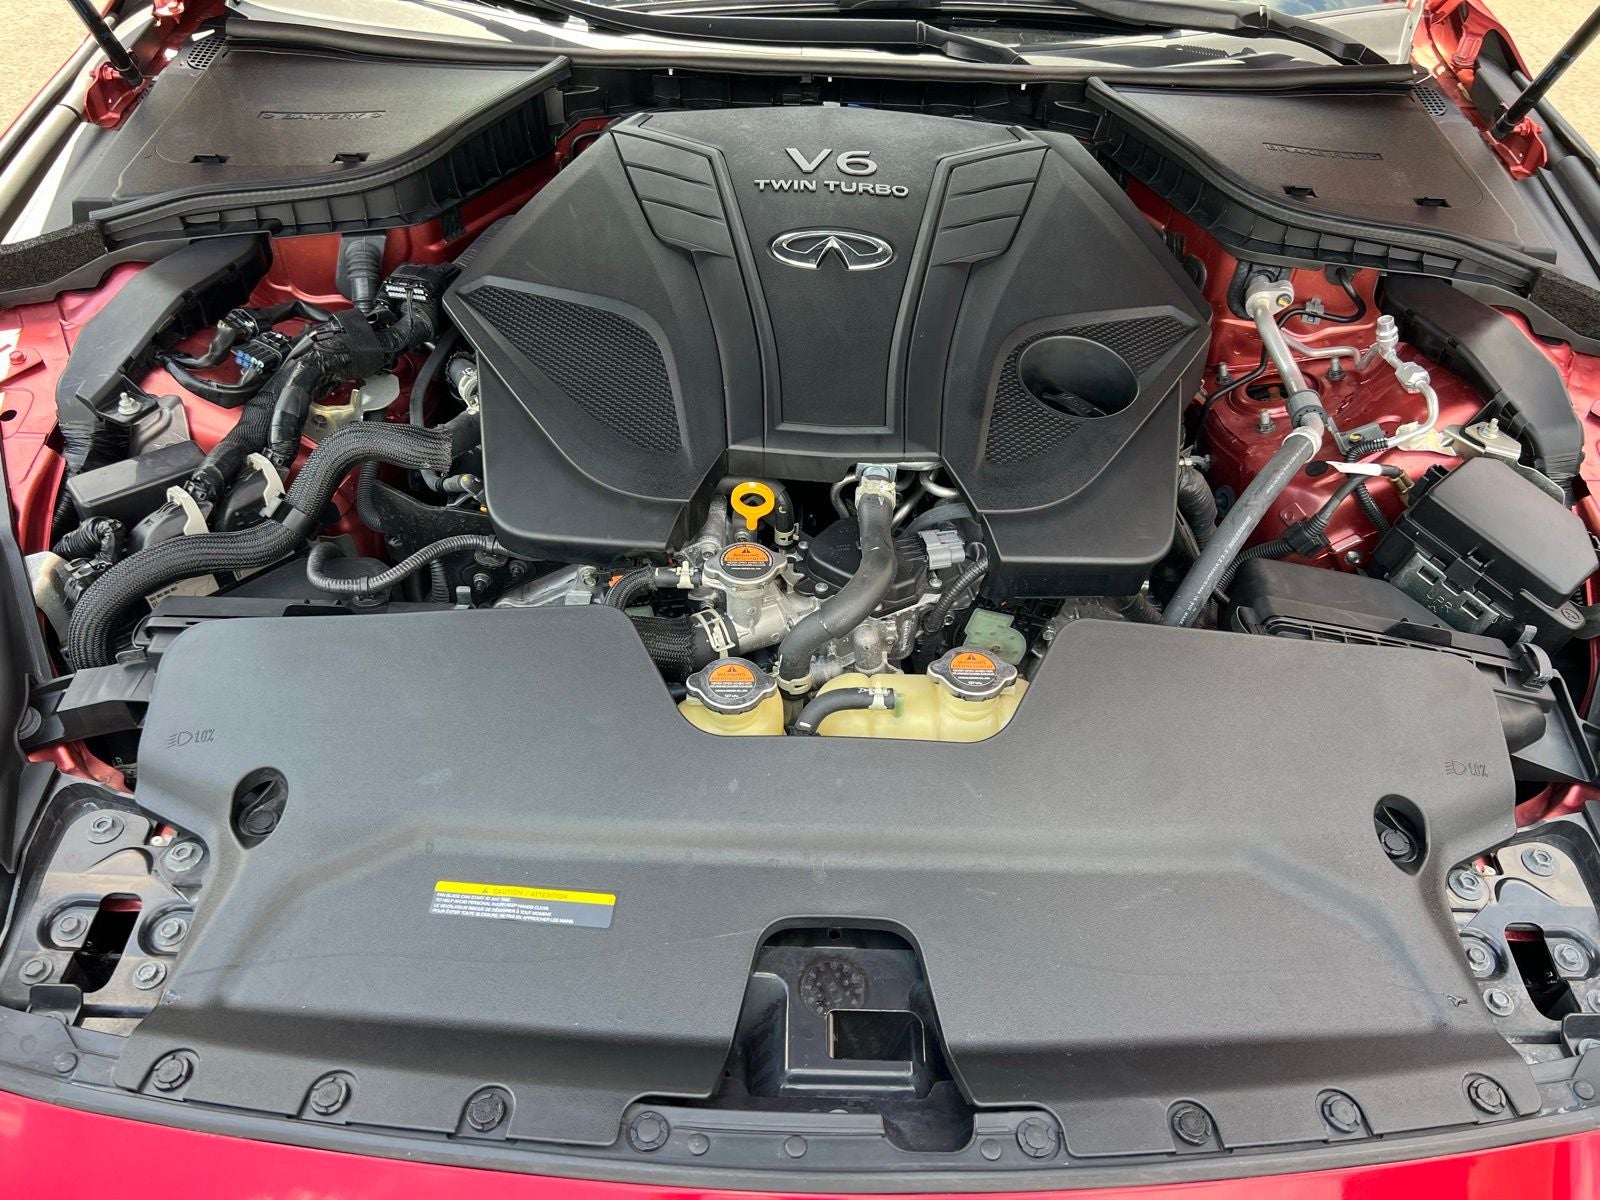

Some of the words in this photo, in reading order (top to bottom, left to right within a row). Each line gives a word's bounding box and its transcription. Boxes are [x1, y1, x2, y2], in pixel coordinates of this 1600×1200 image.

[785, 147, 878, 176] V6
[754, 179, 817, 192] TWIN
[824, 180, 909, 197] TURBO
[493, 888, 524, 896] CAUTION
[530, 891, 569, 899] ATTENTION
